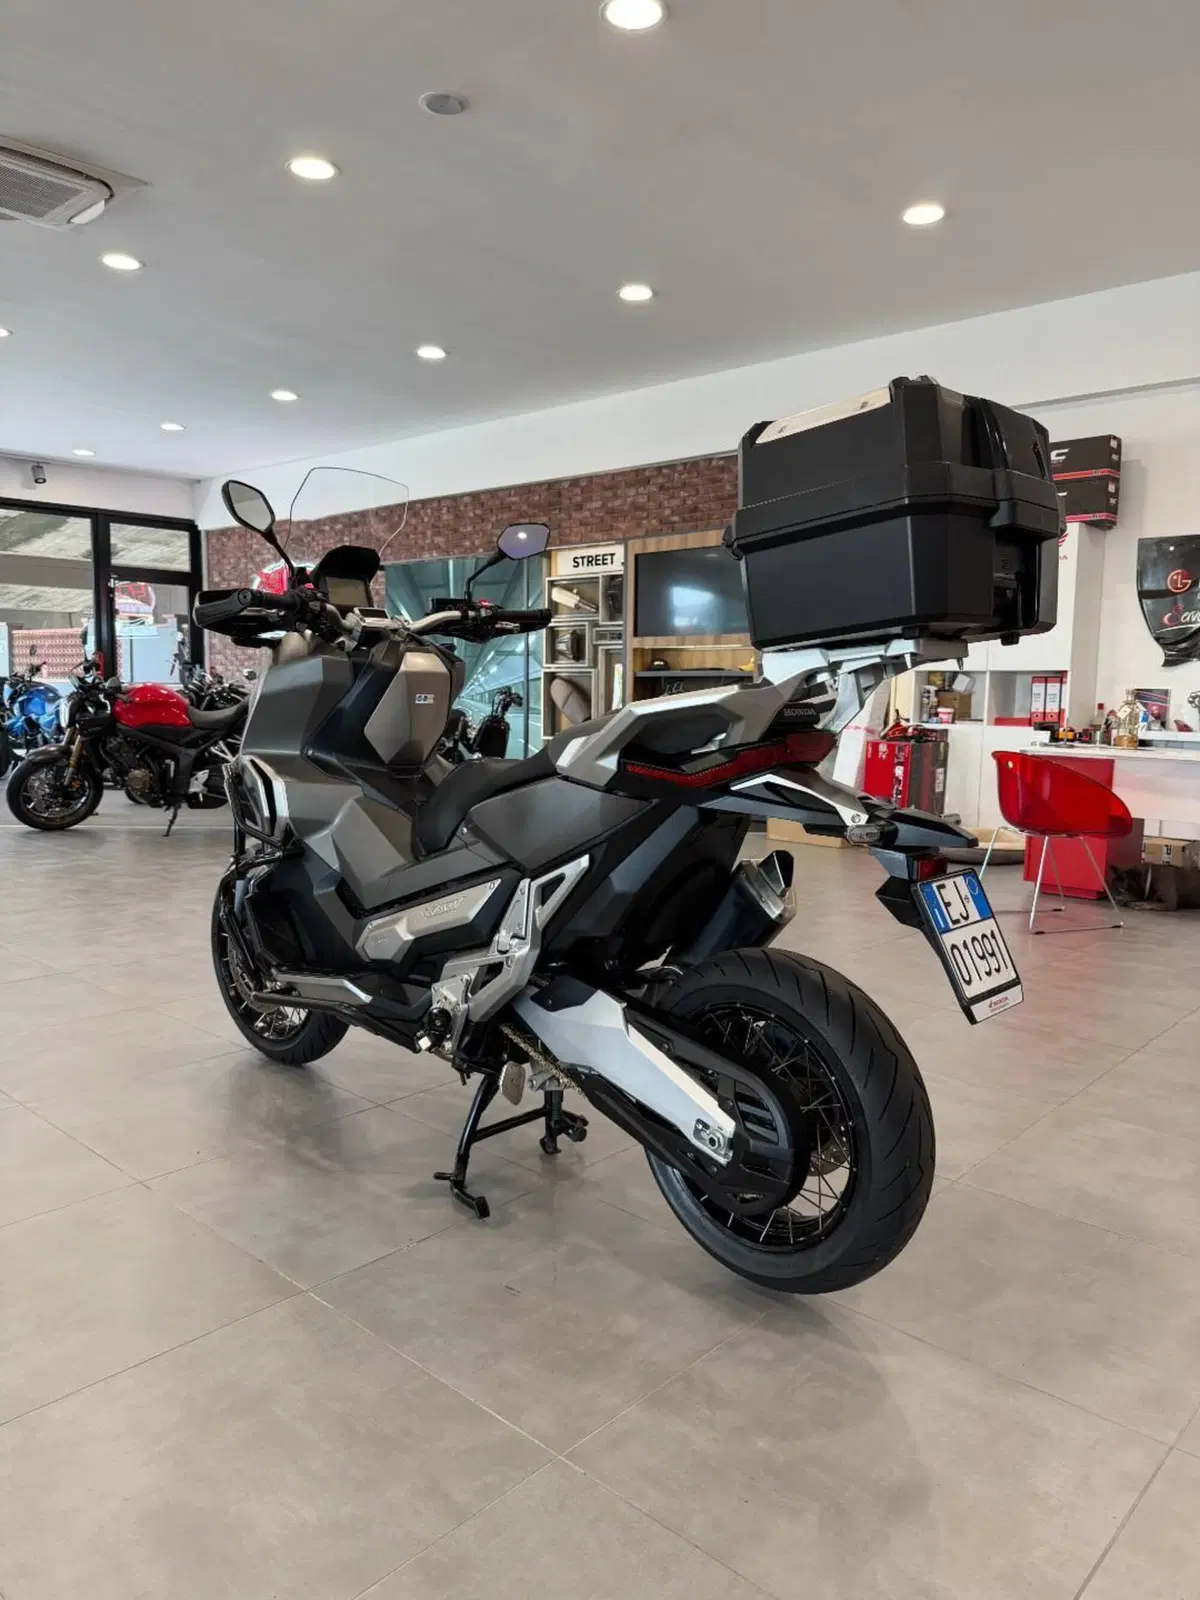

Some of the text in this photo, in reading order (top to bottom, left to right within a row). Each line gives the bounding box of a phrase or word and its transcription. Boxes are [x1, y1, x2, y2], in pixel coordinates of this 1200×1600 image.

[572, 552, 616, 568] STREET
[783, 707, 817, 717] HONDA
[936, 880, 970, 925] EJ
[950, 929, 1008, 986] 01991
